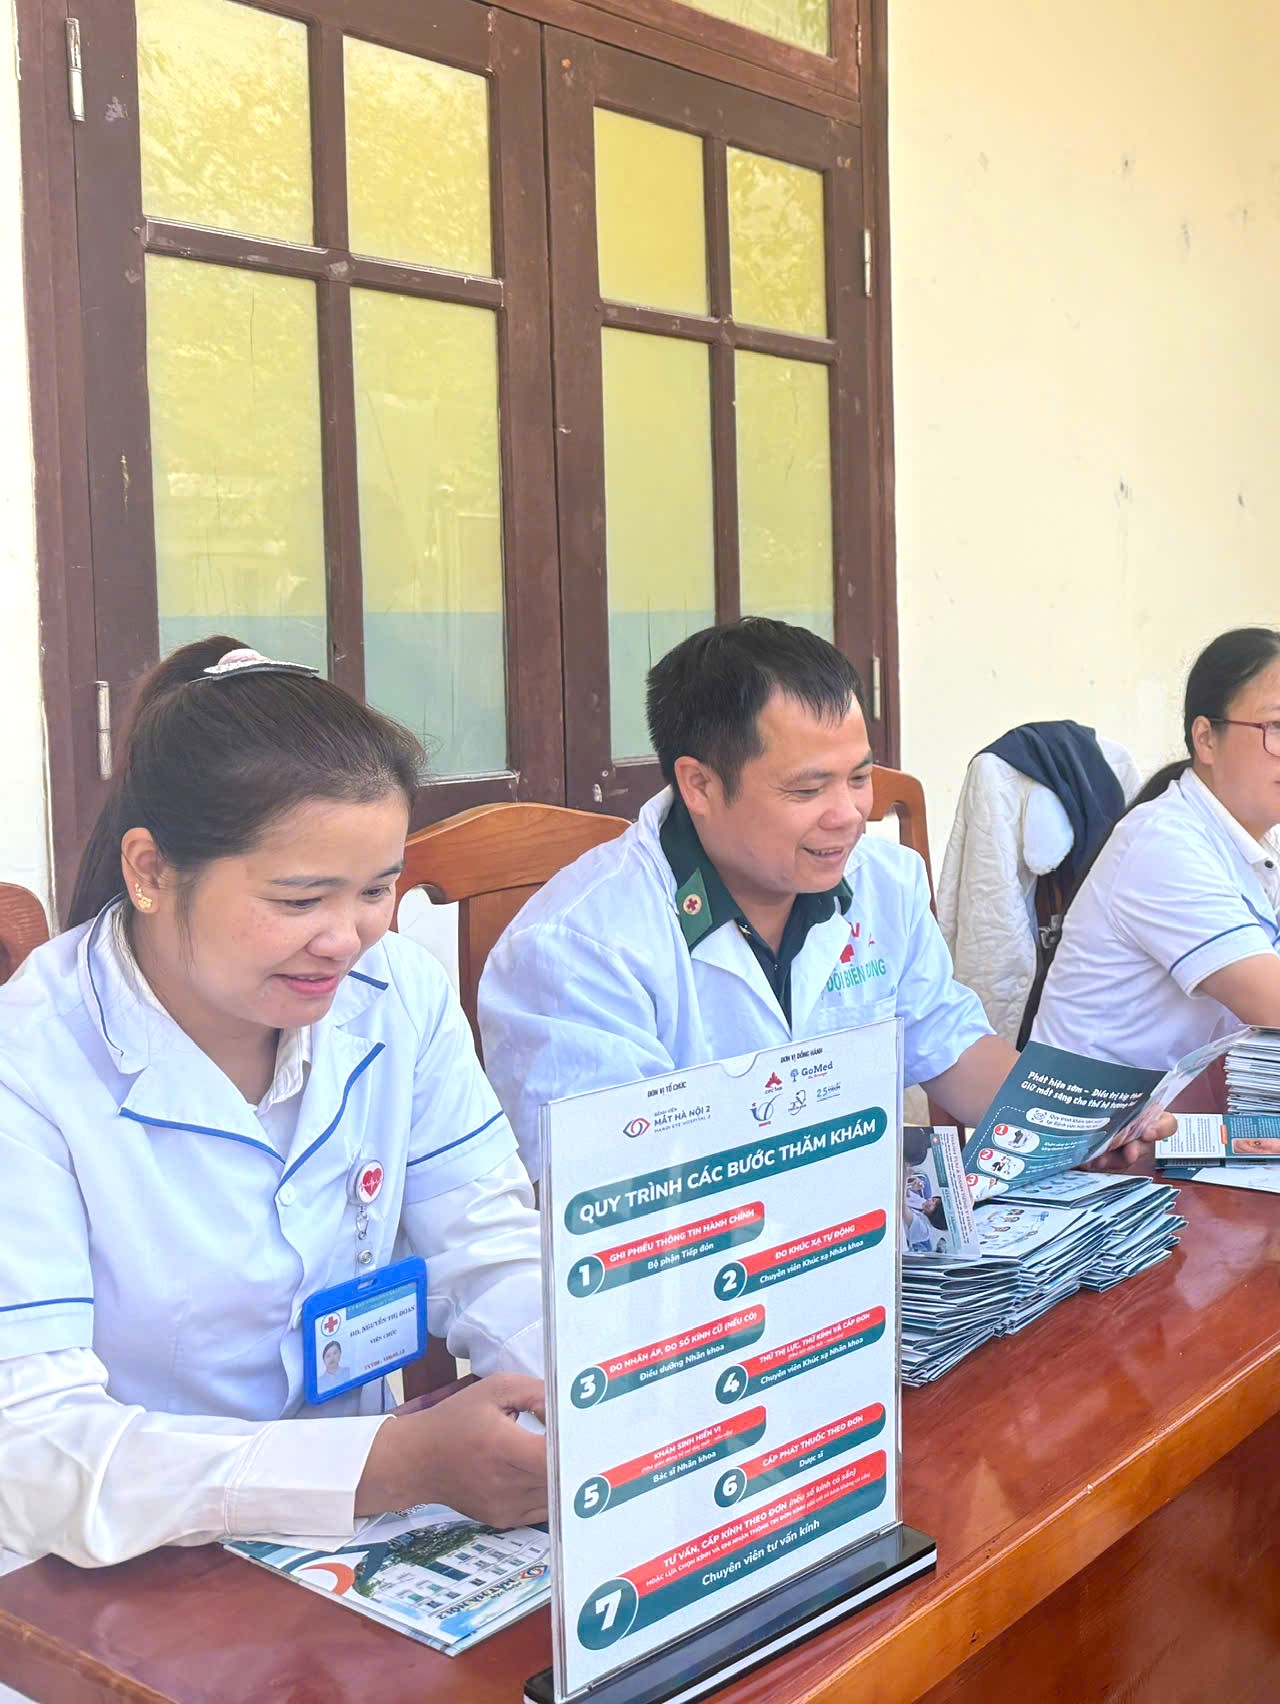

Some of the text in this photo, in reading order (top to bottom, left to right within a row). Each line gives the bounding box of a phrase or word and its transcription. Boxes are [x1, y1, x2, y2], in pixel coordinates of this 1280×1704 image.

[801, 1061, 833, 1076] GoMed
[1028, 1071, 1048, 1084] Phát
[1048, 1077, 1065, 1089] hiện
[1067, 1084, 1082, 1093] sớm
[1021, 1081, 1036, 1091] Giữ
[1036, 1086, 1053, 1097] mắt
[1054, 1090, 1072, 1104] sáng
[1073, 1097, 1087, 1106] cho
[674, 1111, 687, 1120] HÀ
[689, 1106, 704, 1117] NỘI
[998, 1125, 1005, 1134] 1
[983, 1150, 991, 1159] 2
[580, 1118, 876, 1224] QUY TRÌNH CÁC BƯỚC THĂM KHÁM
[968, 1176, 976, 1185] 3
[610, 1209, 755, 1263] GHI PHIẾU THÔNG TIN HÀNH CHÍNH
[775, 1224, 855, 1260] ĐO KHÚC XẠ TỰ ĐỘNG
[648, 1242, 714, 1270] Bộ phận Tiếp đón
[760, 1240, 864, 1283] Chuyên viên Khúc xạ Nhãn khoa
[579, 1264, 590, 1287] 1
[723, 1270, 737, 1292] 2
[610, 1312, 757, 1373] ĐO NHÃN ÁP, ĐO SỐ KÍNH CŨ (NẾU CÓ)
[775, 1348, 786, 1358] THỊ
[787, 1342, 801, 1353] LỰC,
[817, 1330, 832, 1342] KÍNH
[832, 1324, 842, 1334] VÀ
[843, 1318, 855, 1329] CẤP
[856, 1313, 870, 1324] ĐƠN
[640, 1343, 725, 1382] Điều dưỡng Nhãn khoa
[760, 1369, 786, 1385] Chuyên
[787, 1362, 802, 1373] viên
[803, 1355, 820, 1367] Khúc
[820, 1352, 829, 1360] xạ
[830, 1343, 847, 1356] Nhãn
[848, 1337, 864, 1348] khoa
[580, 1374, 596, 1399] 3
[723, 1372, 740, 1393] 4
[654, 1445, 676, 1461] KHÁM
[677, 1437, 695, 1450] SINH
[714, 1426, 722, 1435] VỊ
[762, 1415, 864, 1467] CẤP PHÁT THUỐC THEO ĐƠN
[653, 1470, 668, 1483] Bác
[668, 1465, 676, 1476] sĩ
[677, 1458, 697, 1473] Nhãn
[698, 1451, 716, 1463] khoa
[799, 1450, 824, 1468] Dược sĩ
[584, 1484, 600, 1509] 5
[722, 1475, 738, 1497] 6
[664, 1555, 678, 1567] TƯ
[678, 1544, 700, 1559] VẤN,
[701, 1533, 720, 1549] CẤP
[721, 1524, 742, 1540] KÍNH
[744, 1512, 767, 1528] THEO
[768, 1502, 787, 1516] ĐƠN
[806, 1487, 815, 1497] số
[815, 1481, 831, 1492] kính
[832, 1476, 841, 1484] có
[841, 1468, 857, 1480] sẵn)
[702, 1520, 820, 1586] Chuyên viên tư vấn kính
[595, 1589, 622, 1630] 7
